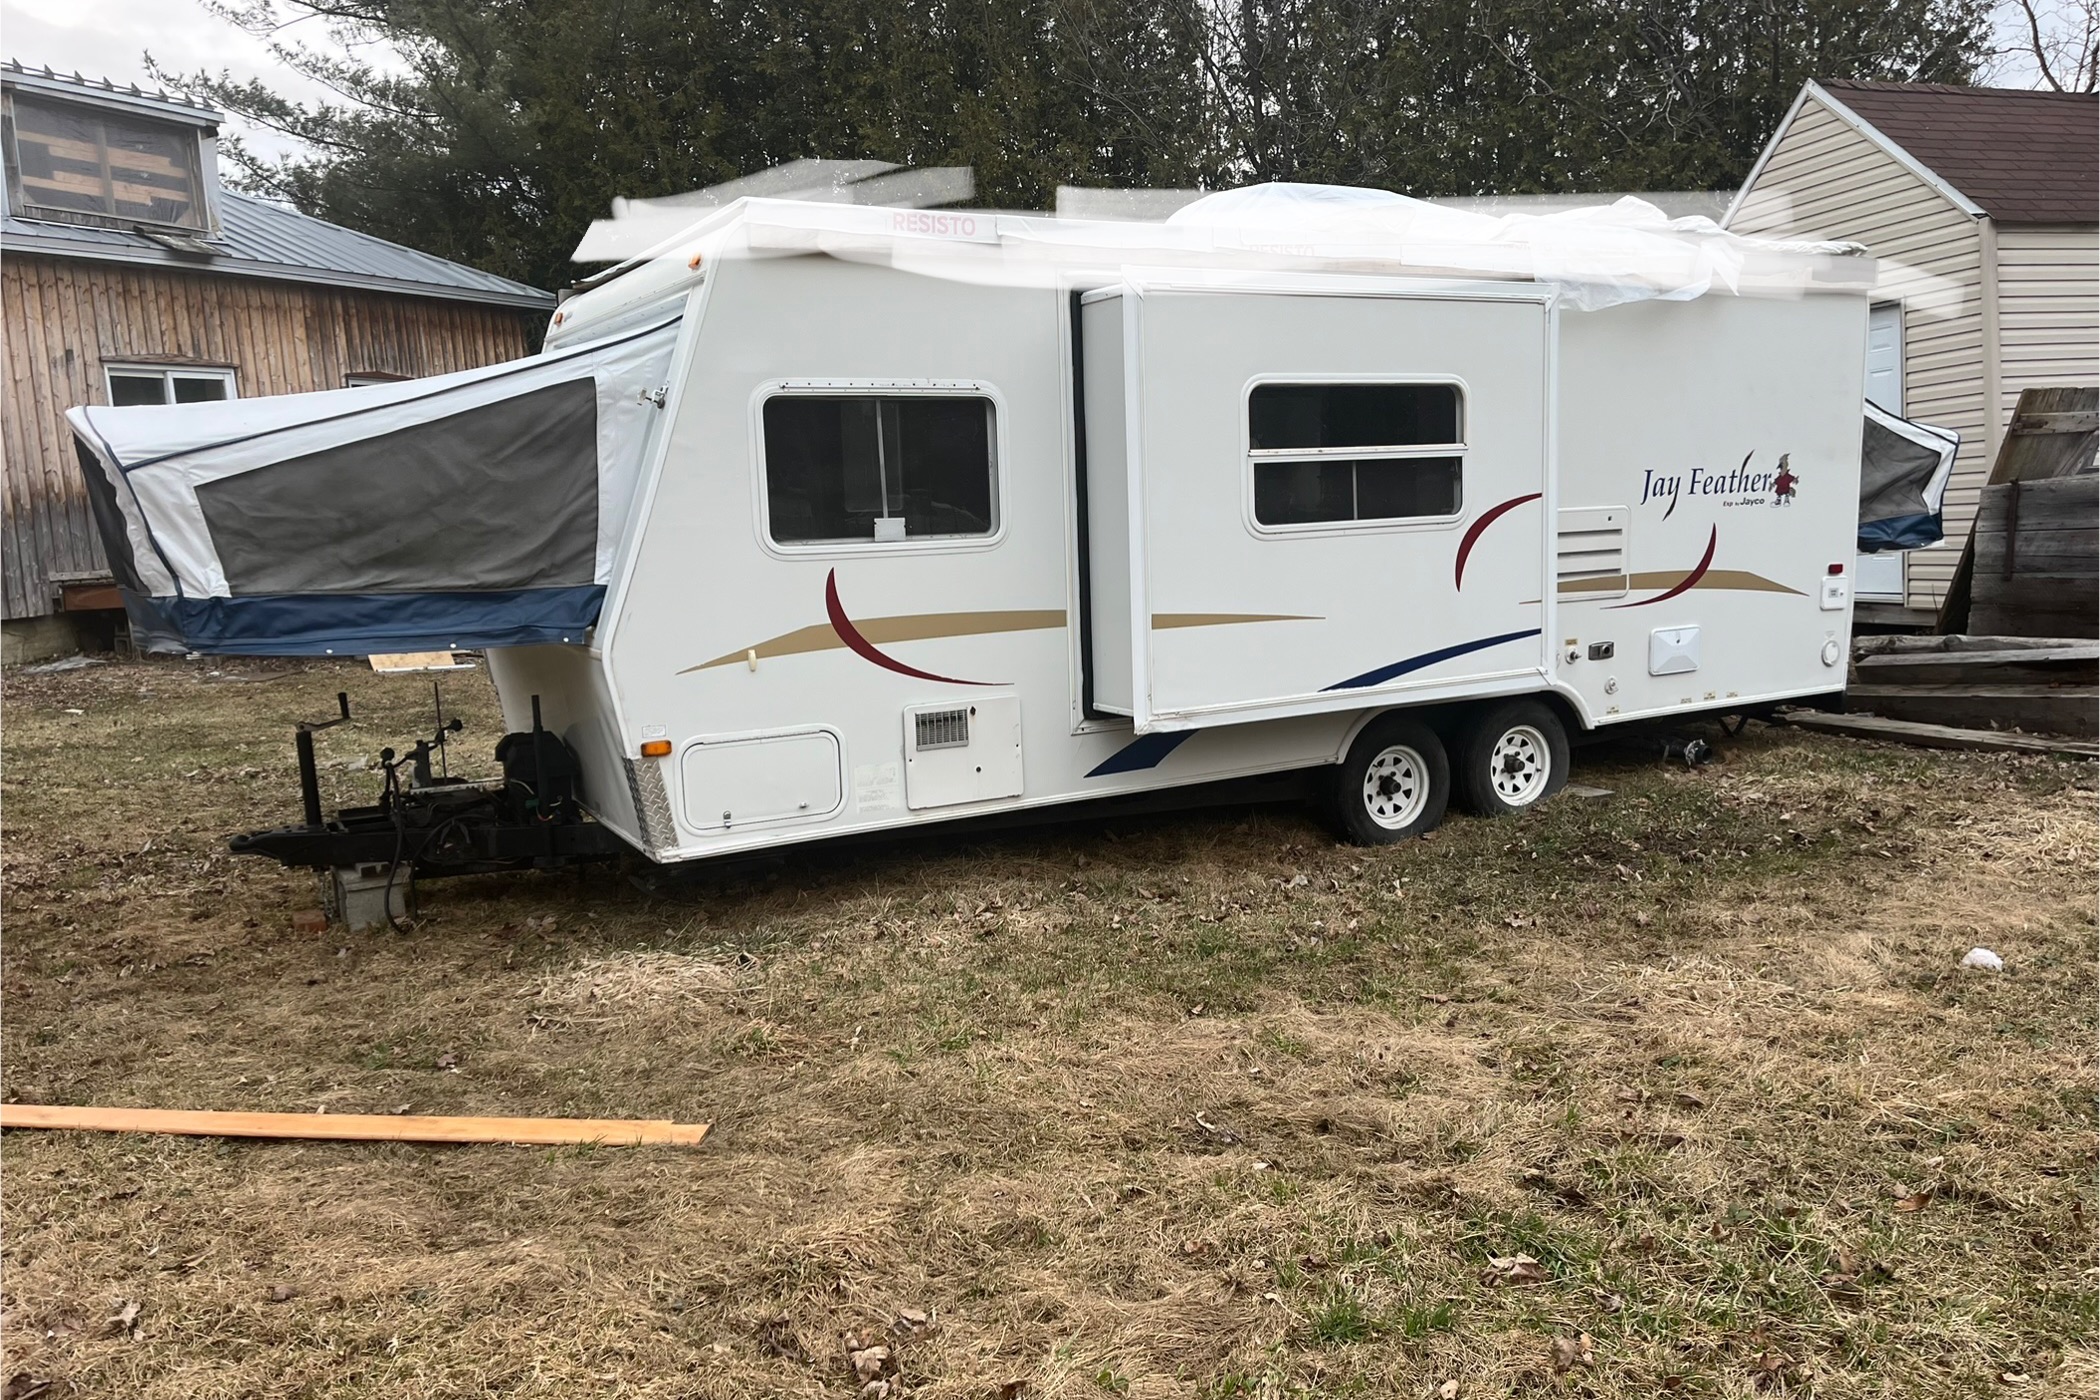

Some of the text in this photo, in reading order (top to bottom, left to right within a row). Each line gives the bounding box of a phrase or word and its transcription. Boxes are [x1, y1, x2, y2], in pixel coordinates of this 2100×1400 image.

[893, 212, 976, 237] RESISTO
[1640, 448, 1772, 521] Jay Feather
[1739, 497, 1766, 507] Jayco
